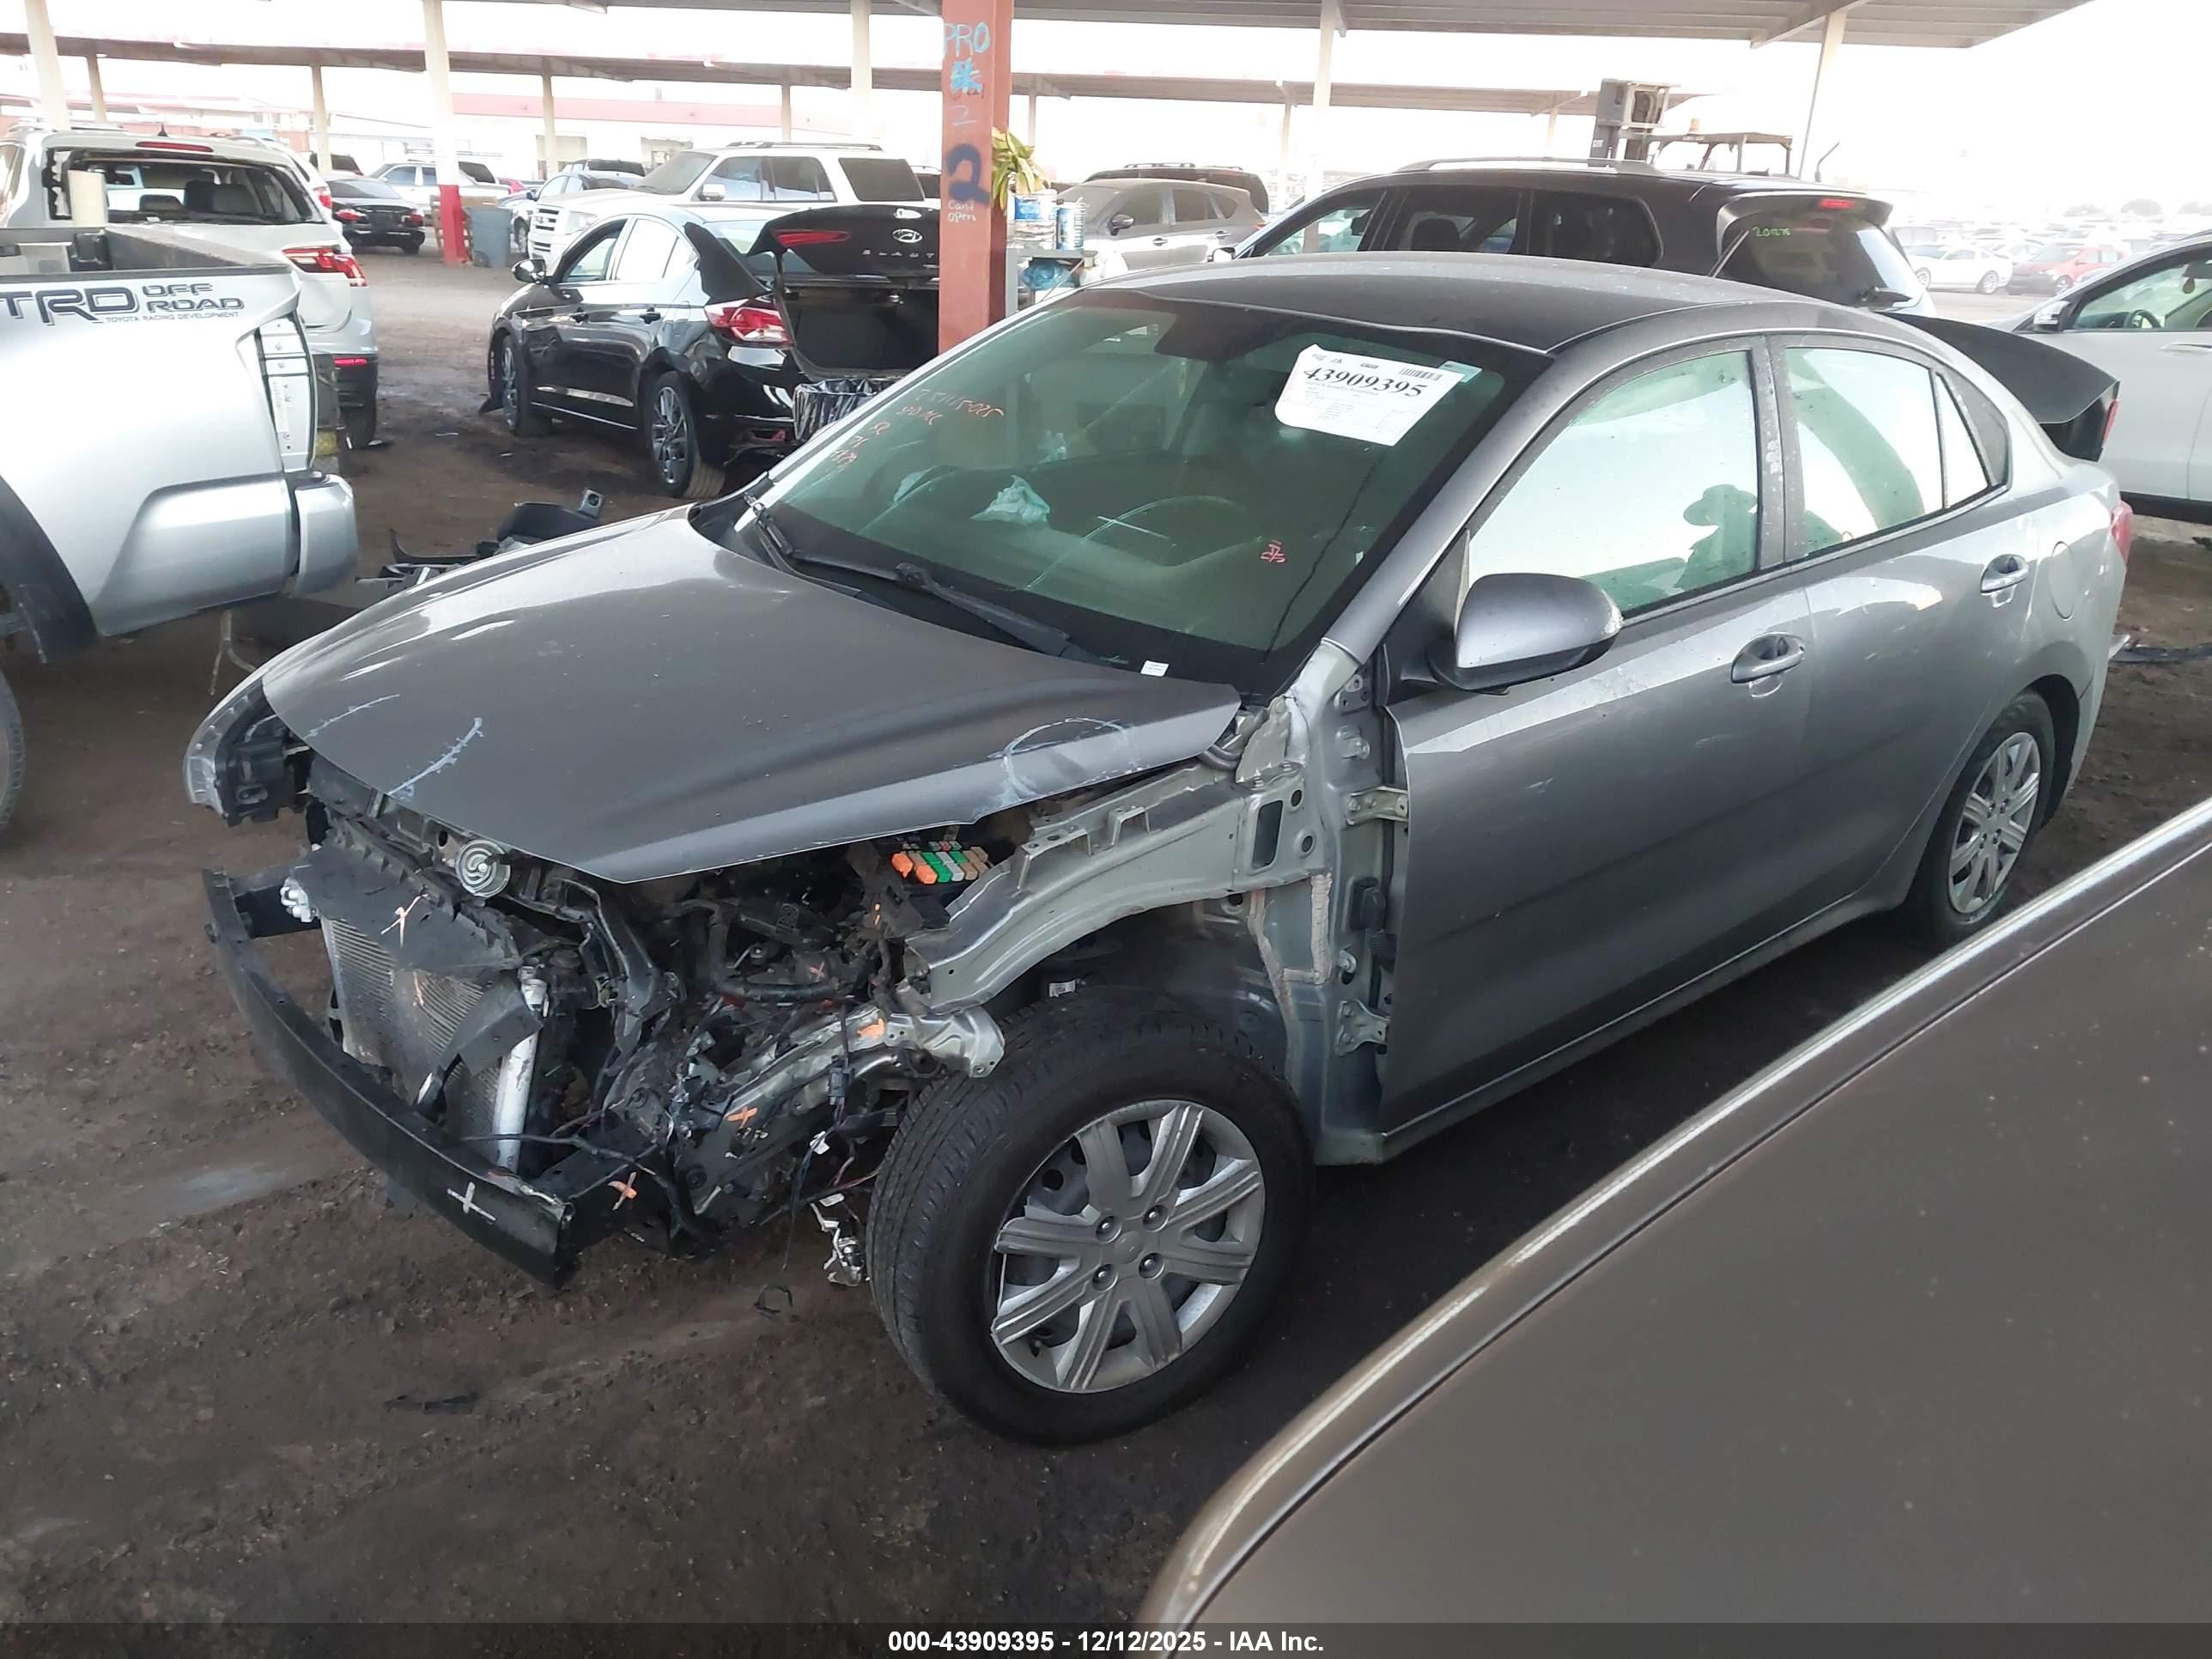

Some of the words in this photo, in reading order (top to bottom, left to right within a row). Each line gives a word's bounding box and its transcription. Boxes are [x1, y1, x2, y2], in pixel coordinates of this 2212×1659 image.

[944, 21, 990, 57] PRO
[946, 143, 992, 204] 2
[0, 287, 140, 325] TRD
[142, 283, 212, 296] OFF
[148, 297, 244, 313] ROAD
[177, 311, 240, 320] DEVELOPMENT
[1304, 366, 1429, 398] 43909395
